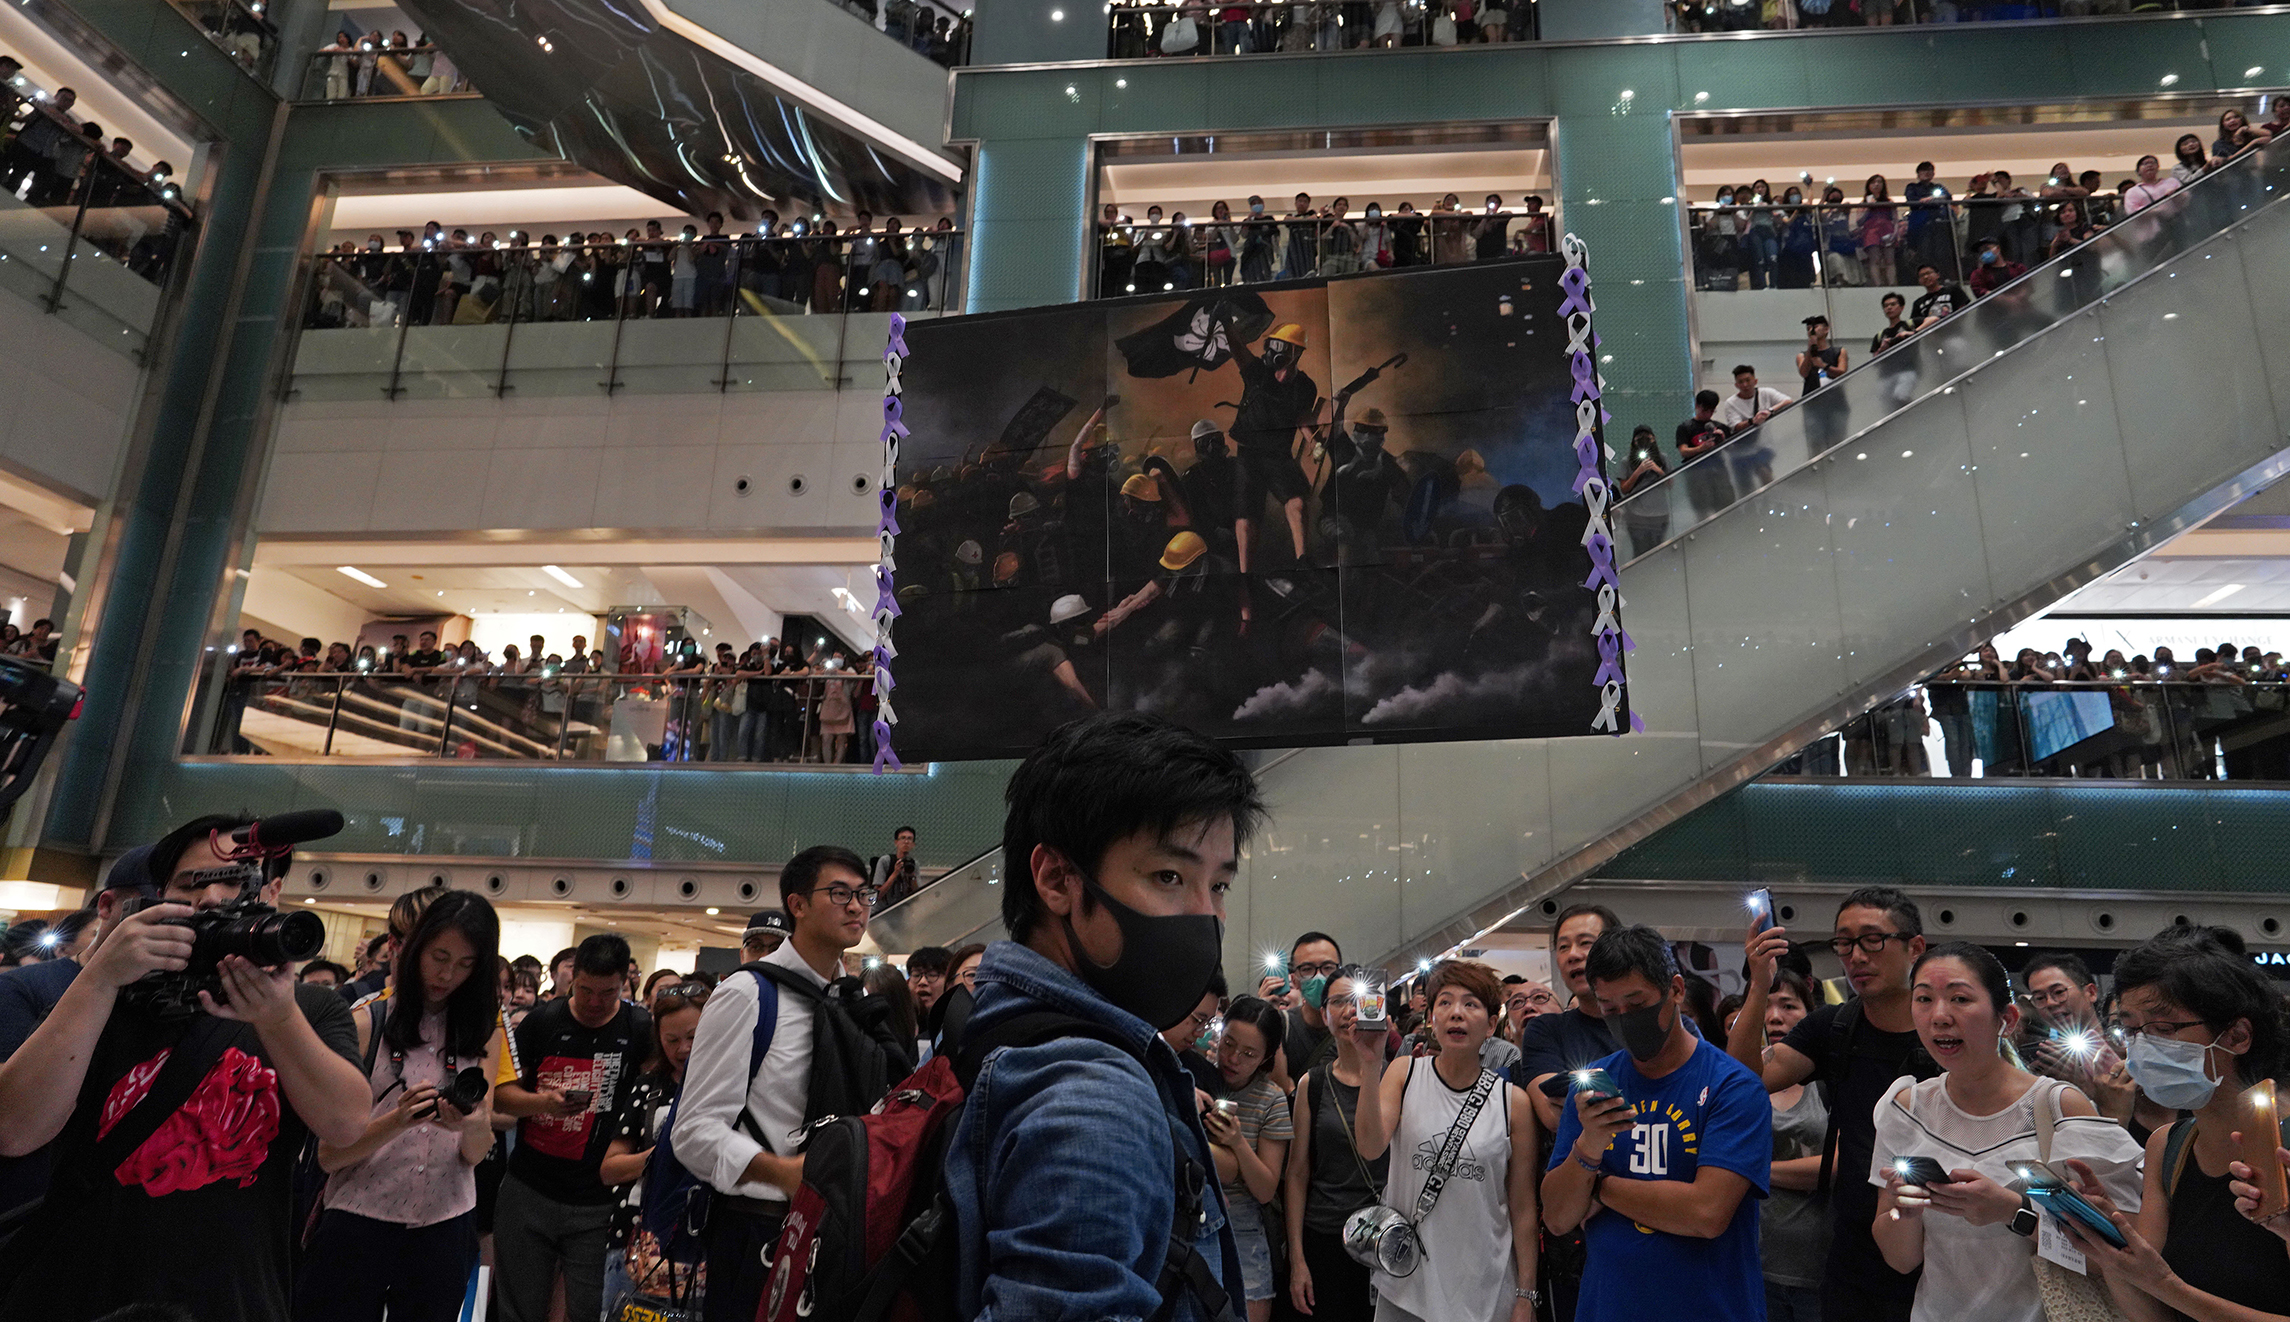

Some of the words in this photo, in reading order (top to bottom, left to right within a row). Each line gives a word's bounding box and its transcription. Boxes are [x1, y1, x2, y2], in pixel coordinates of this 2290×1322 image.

[2149, 635, 2198, 645] ARMANI
[2204, 635, 2273, 645] EXCHANGE
[1629, 1123, 1669, 1175] 30
[1666, 1103, 1698, 1155] CURRY
[1411, 1153, 1485, 1182] addas
